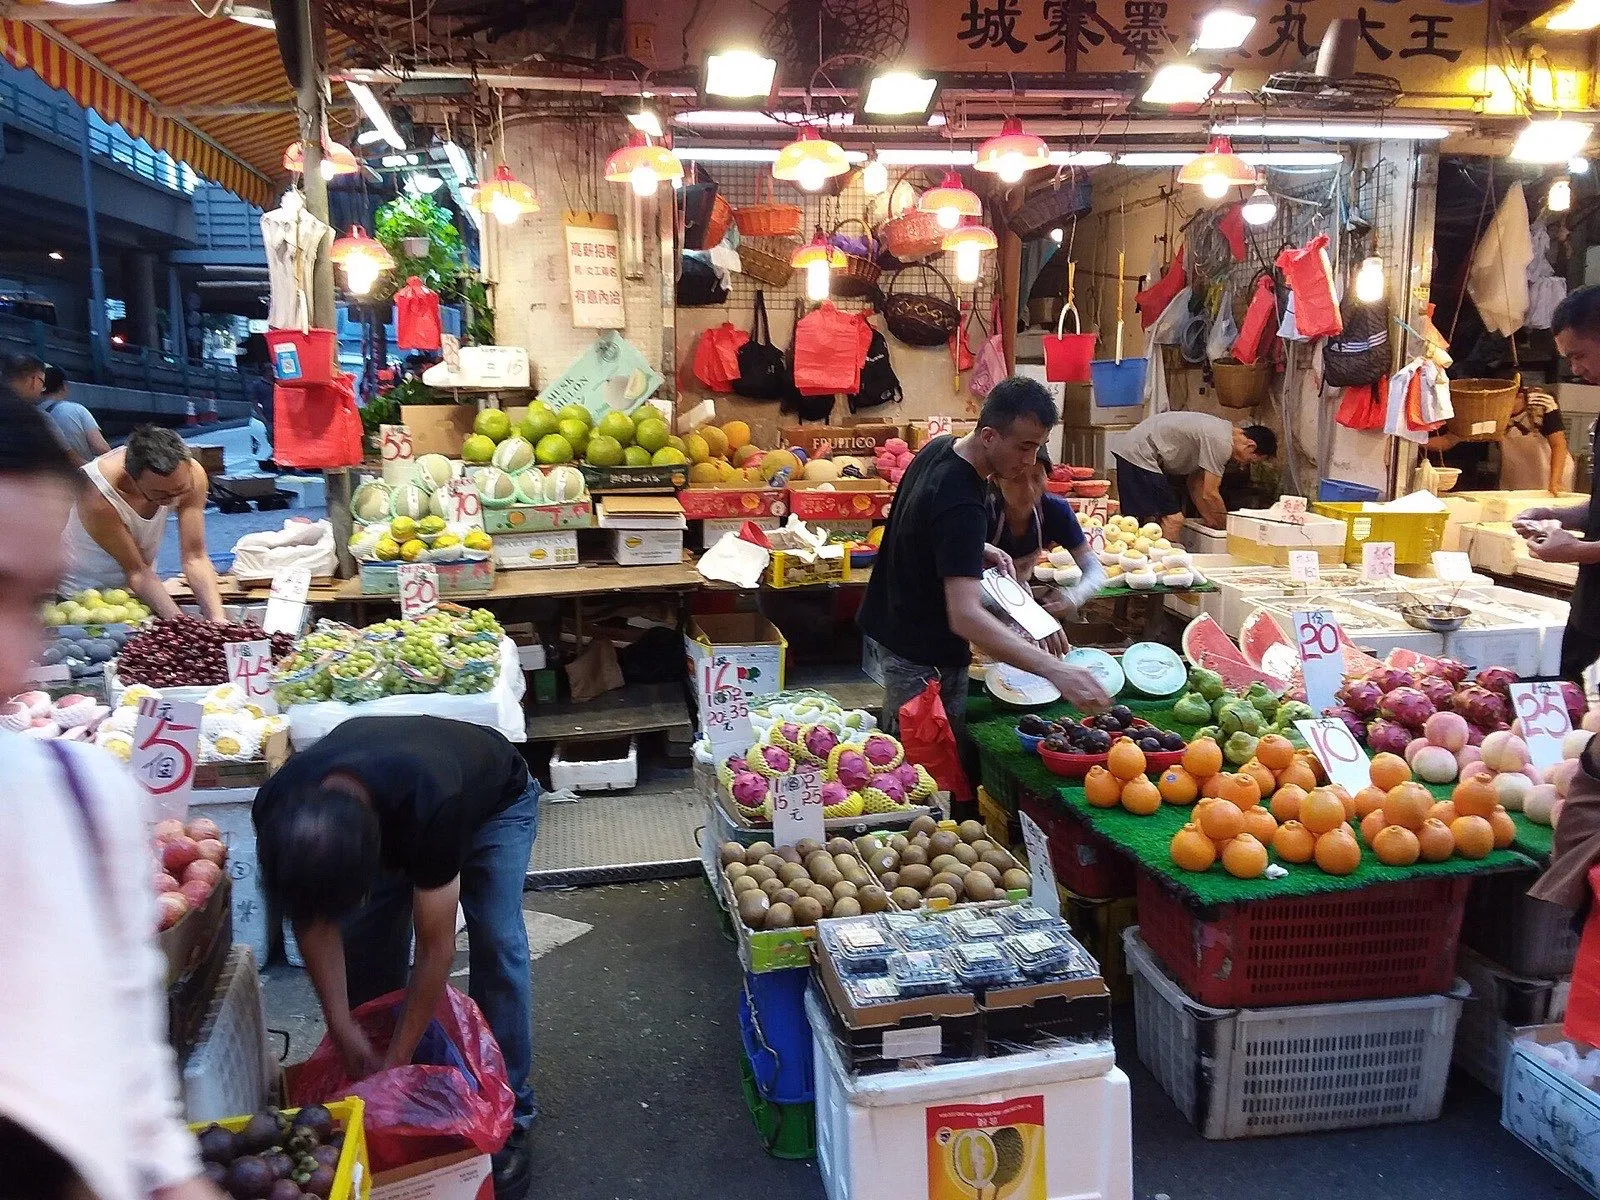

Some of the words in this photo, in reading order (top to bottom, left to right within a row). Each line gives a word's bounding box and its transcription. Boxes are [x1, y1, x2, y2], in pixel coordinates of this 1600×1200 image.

[957, 0, 1463, 66] 城寨墨丸大王
[382, 432, 413, 460] 55
[405, 579, 437, 610] 20
[1300, 623, 1339, 661] 20
[707, 711, 725, 727] 20
[730, 702, 749, 719] 35
[1517, 690, 1569, 738] 25
[138, 719, 198, 795] 5
[1310, 725, 1360, 774] 10
[773, 794, 789, 811] 15
[801, 789, 822, 806] 25
[789, 808, 804, 821] 元
